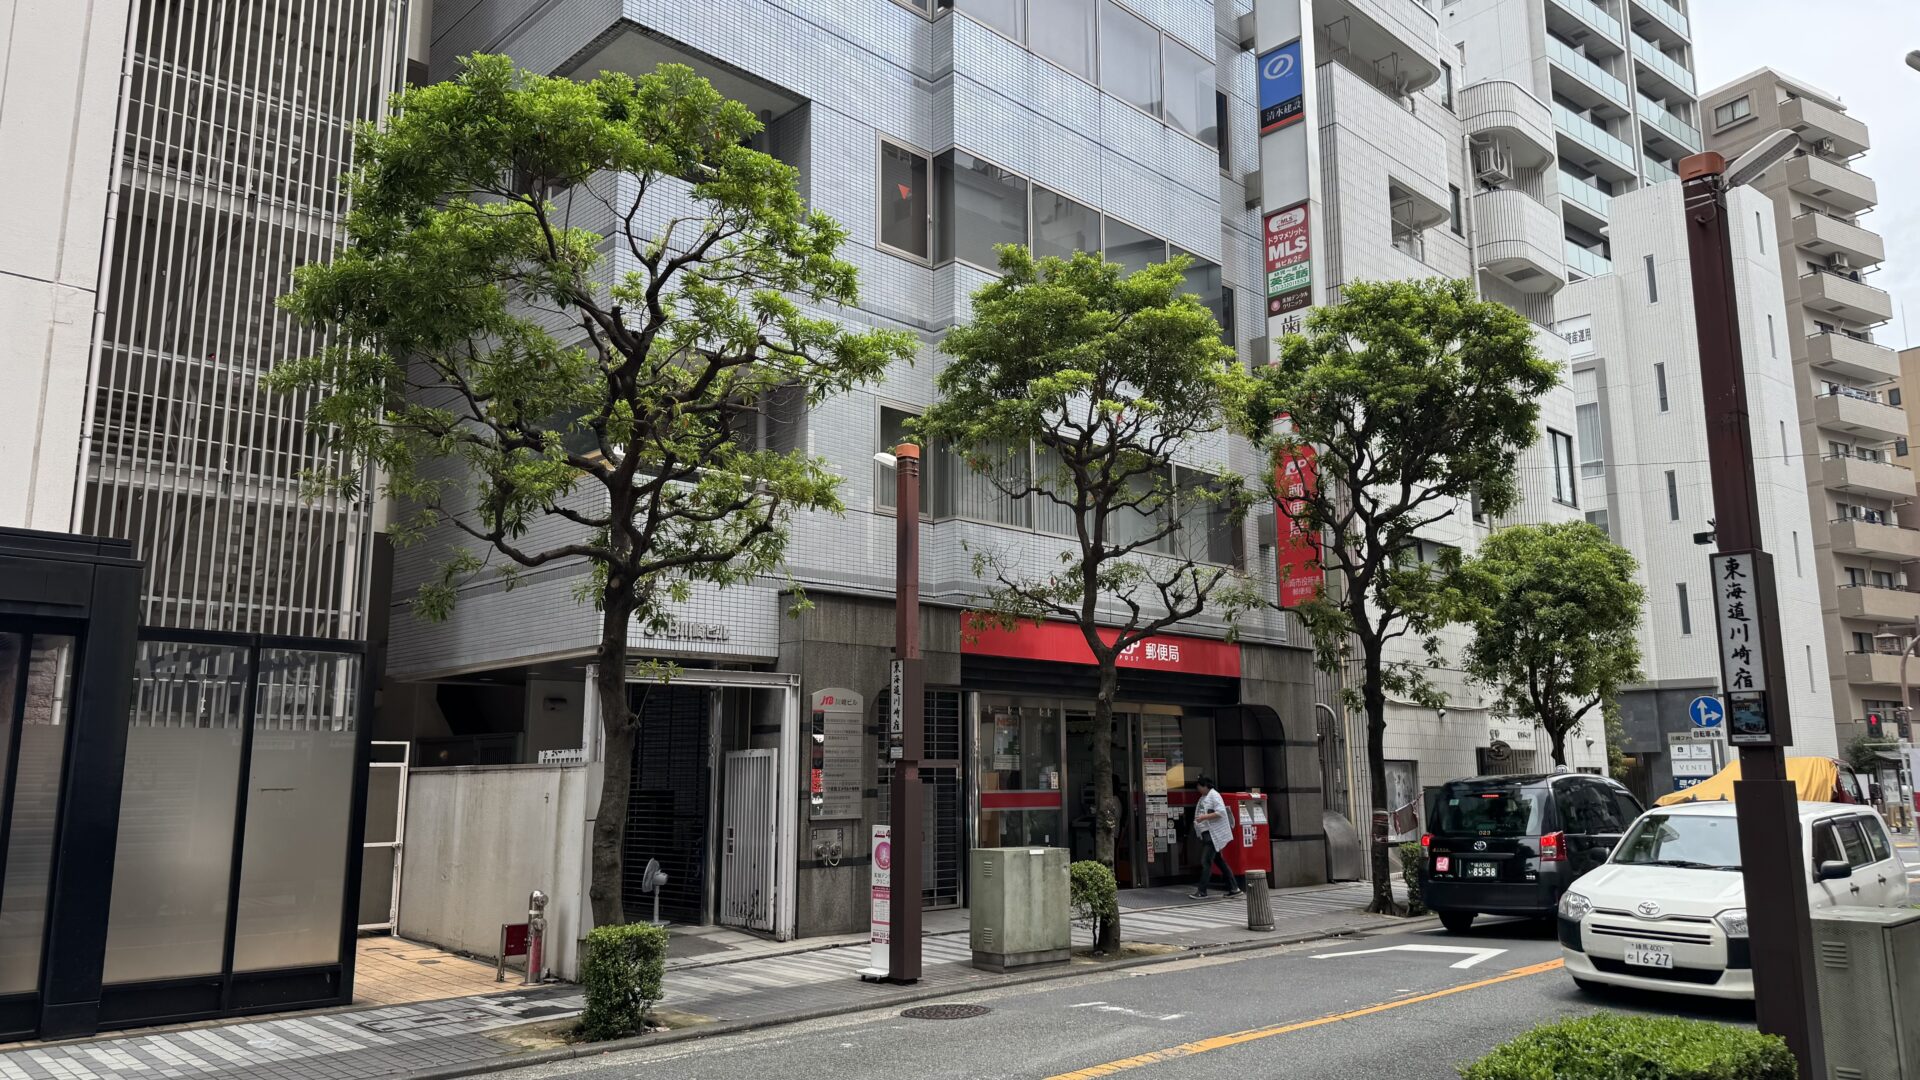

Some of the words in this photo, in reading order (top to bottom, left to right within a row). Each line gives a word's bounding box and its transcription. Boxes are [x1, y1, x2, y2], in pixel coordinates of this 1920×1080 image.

[1266, 100, 1301, 121] 清水建設
[1268, 226, 1303, 245] ドラマメソッド
[1268, 236, 1307, 261] MLS
[1270, 268, 1308, 287] 英会話
[1282, 299, 1303, 309] クリニック
[1723, 557, 1752, 689] 東海道川崎宿
[1119, 654, 1139, 662] POST
[1145, 642, 1180, 663] 郵便局
[820, 695, 834, 706] JTB
[893, 661, 901, 731] 東海道川崎宿
